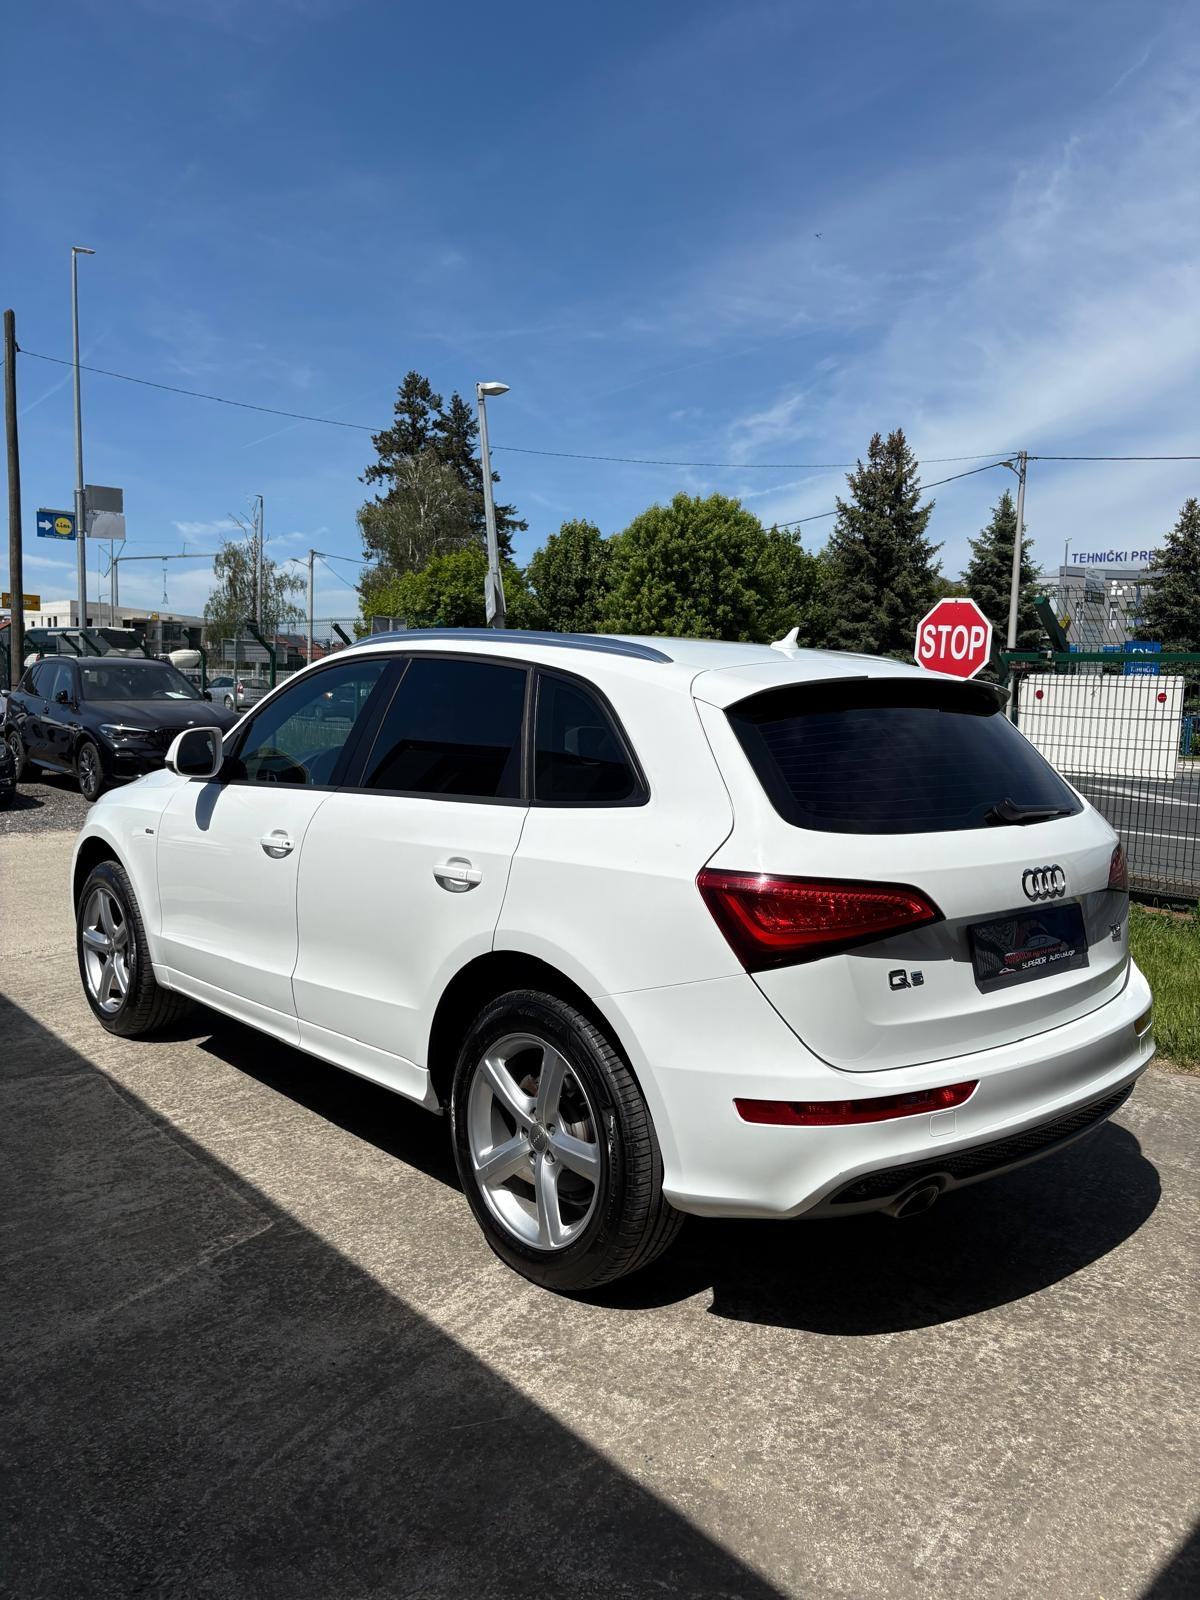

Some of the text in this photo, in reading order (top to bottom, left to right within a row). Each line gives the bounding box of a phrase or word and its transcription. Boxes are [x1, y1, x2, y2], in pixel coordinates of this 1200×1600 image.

[1071, 550, 1128, 564] TEHNIČKI
[921, 624, 985, 660] STOP
[1021, 956, 1047, 969] SUPERIOR
[888, 968, 925, 992] Q5
